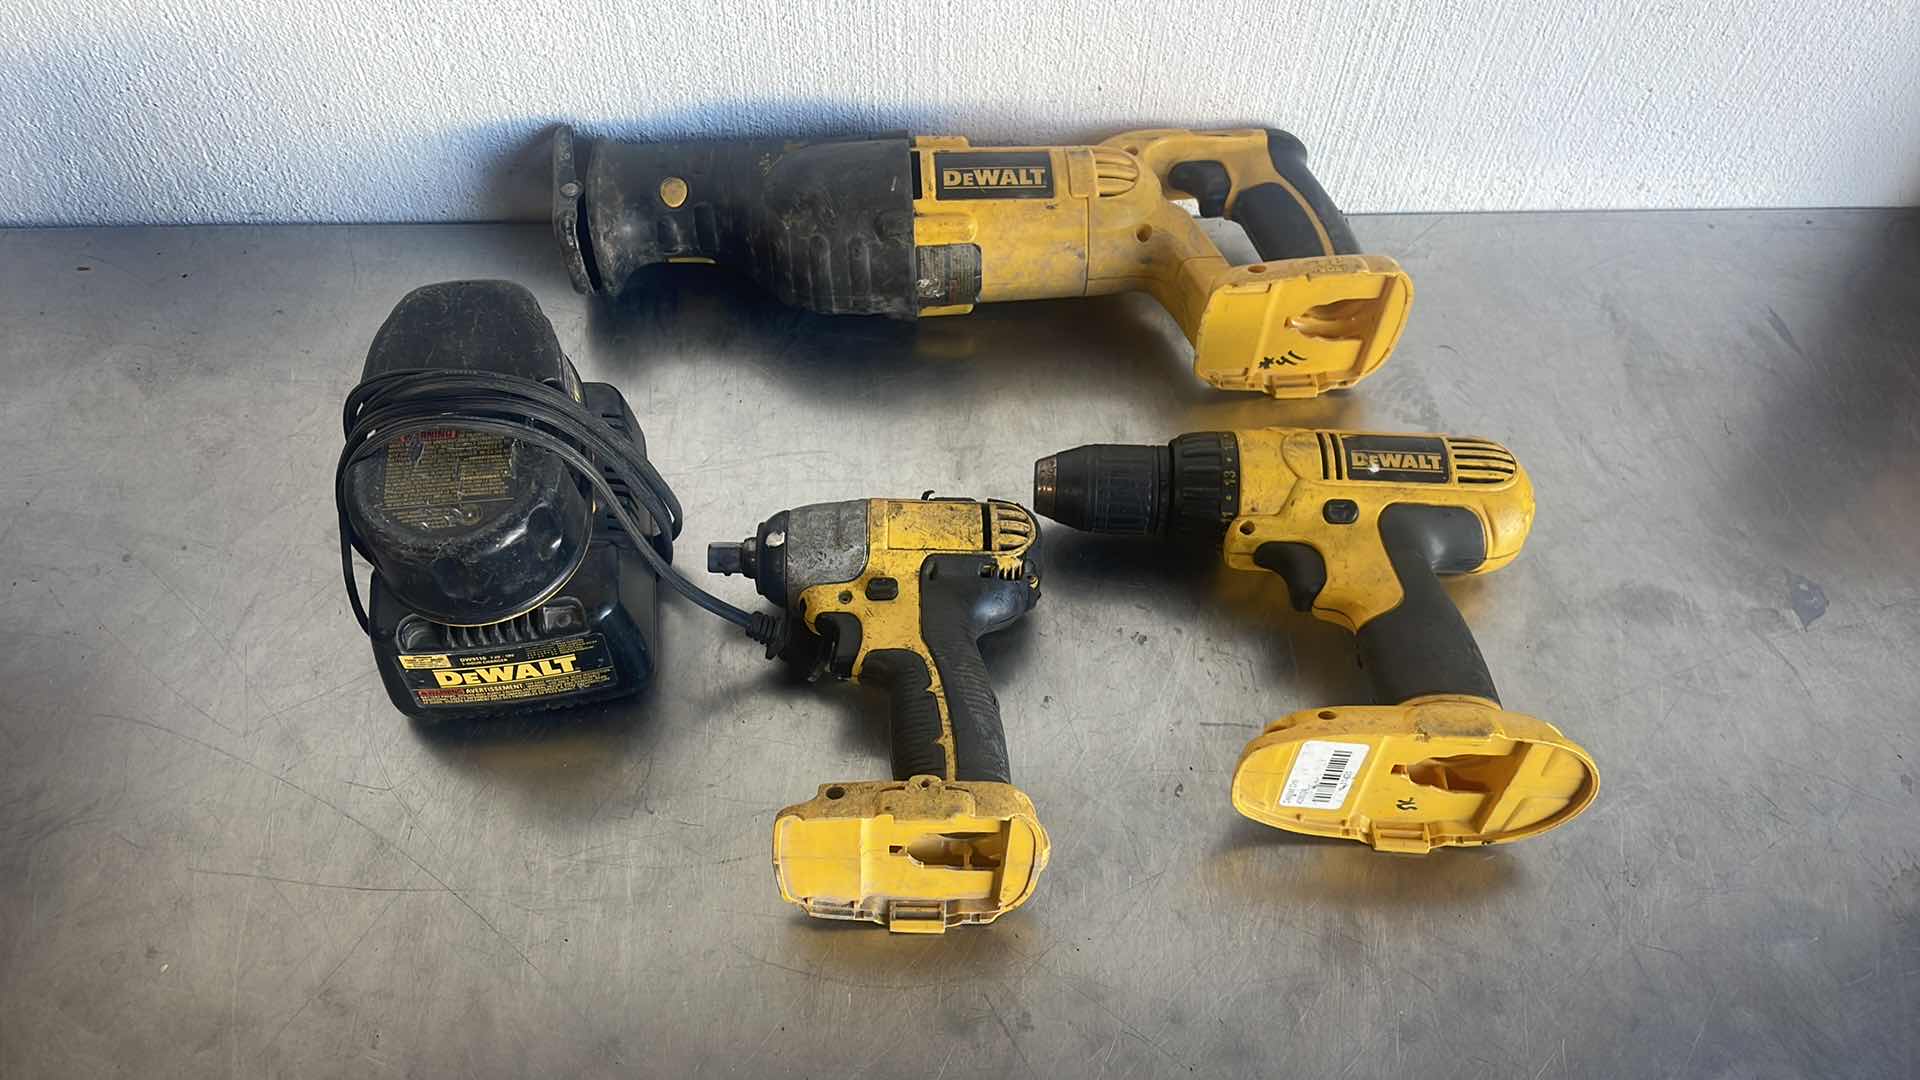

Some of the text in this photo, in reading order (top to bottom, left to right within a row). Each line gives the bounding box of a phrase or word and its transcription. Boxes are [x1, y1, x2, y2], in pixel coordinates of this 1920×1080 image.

[942, 168, 1046, 187] DEWALT
[1352, 453, 1442, 470] DEWALT
[432, 655, 577, 688] DEWALT
